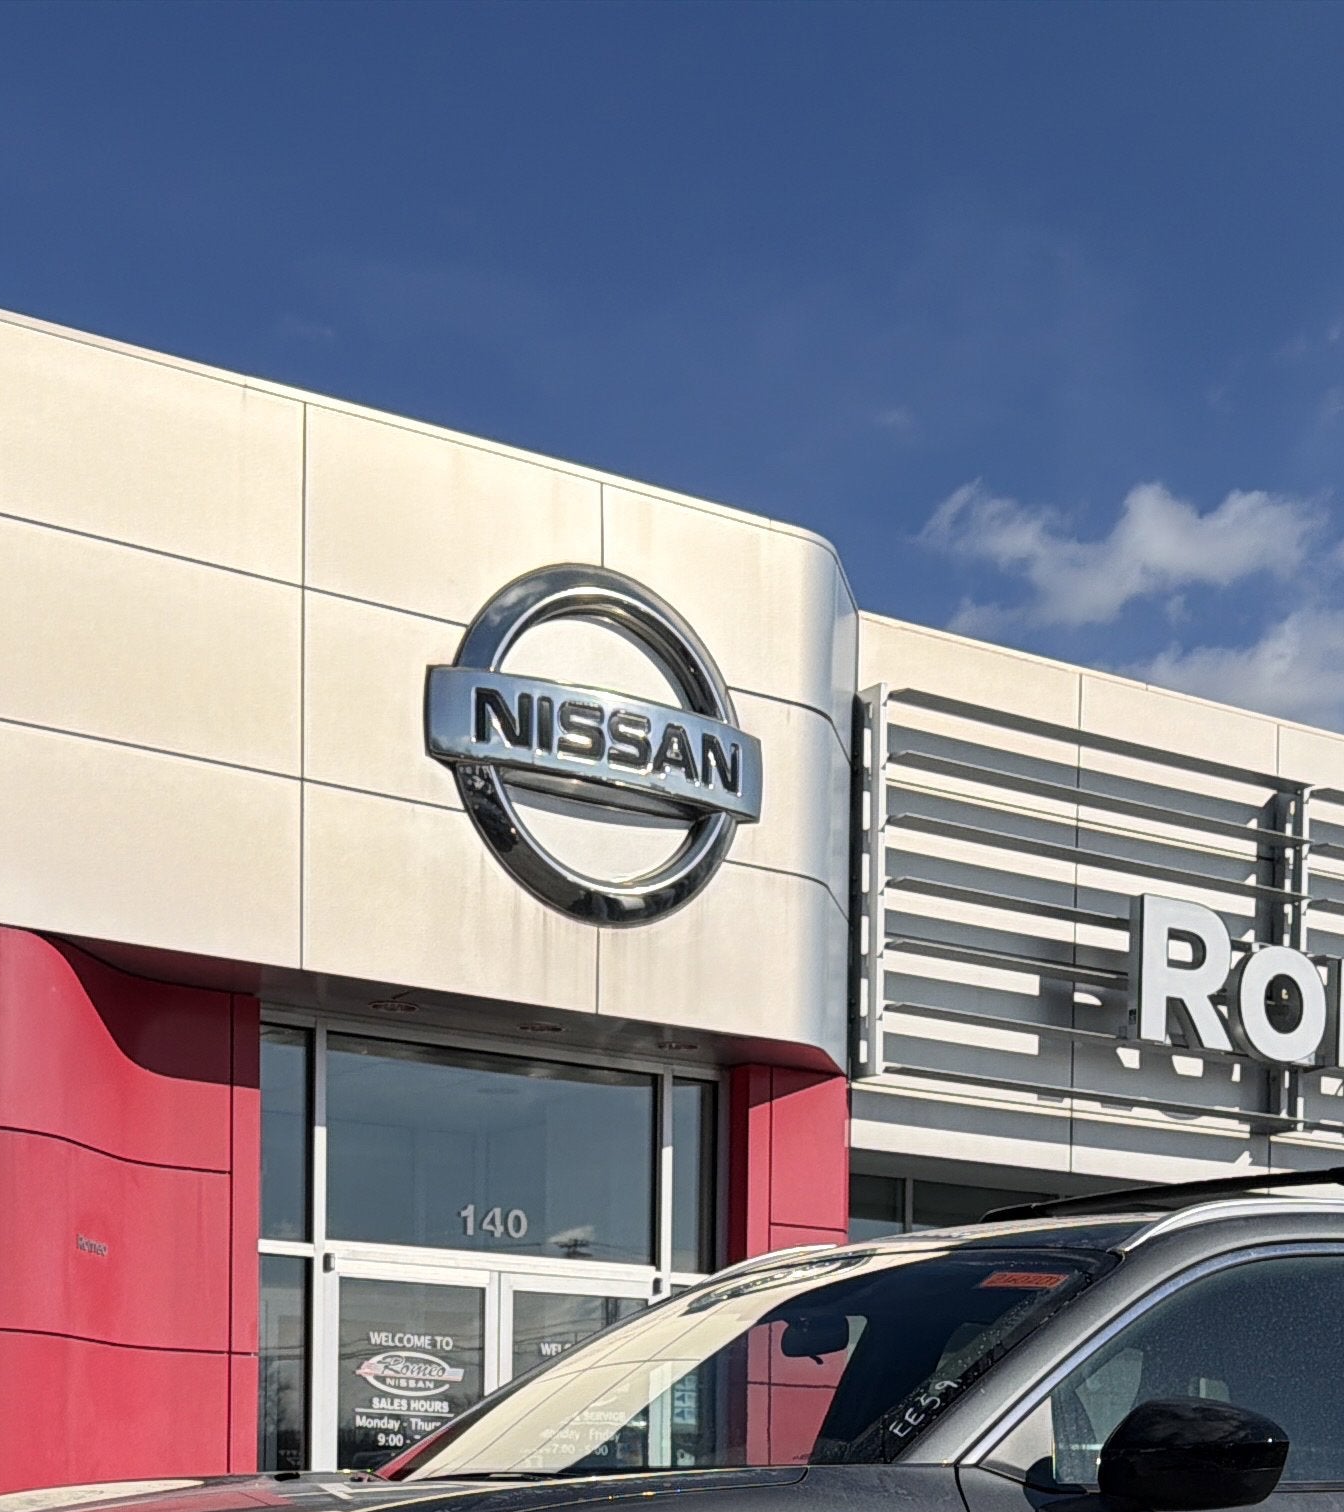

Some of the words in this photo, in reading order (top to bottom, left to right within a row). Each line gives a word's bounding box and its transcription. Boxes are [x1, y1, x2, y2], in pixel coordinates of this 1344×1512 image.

[471, 686, 743, 798] NISSAN
[458, 1203, 529, 1240] 140
[369, 1331, 432, 1350] WELCOME
[434, 1336, 454, 1351] TO
[376, 1355, 446, 1378] Romeo
[385, 1378, 435, 1389] NISSAN
[372, 1397, 408, 1411] SALES
[410, 1400, 450, 1413] HOURS
[356, 1415, 400, 1432] Monday
[377, 1433, 404, 1447] 9:00
